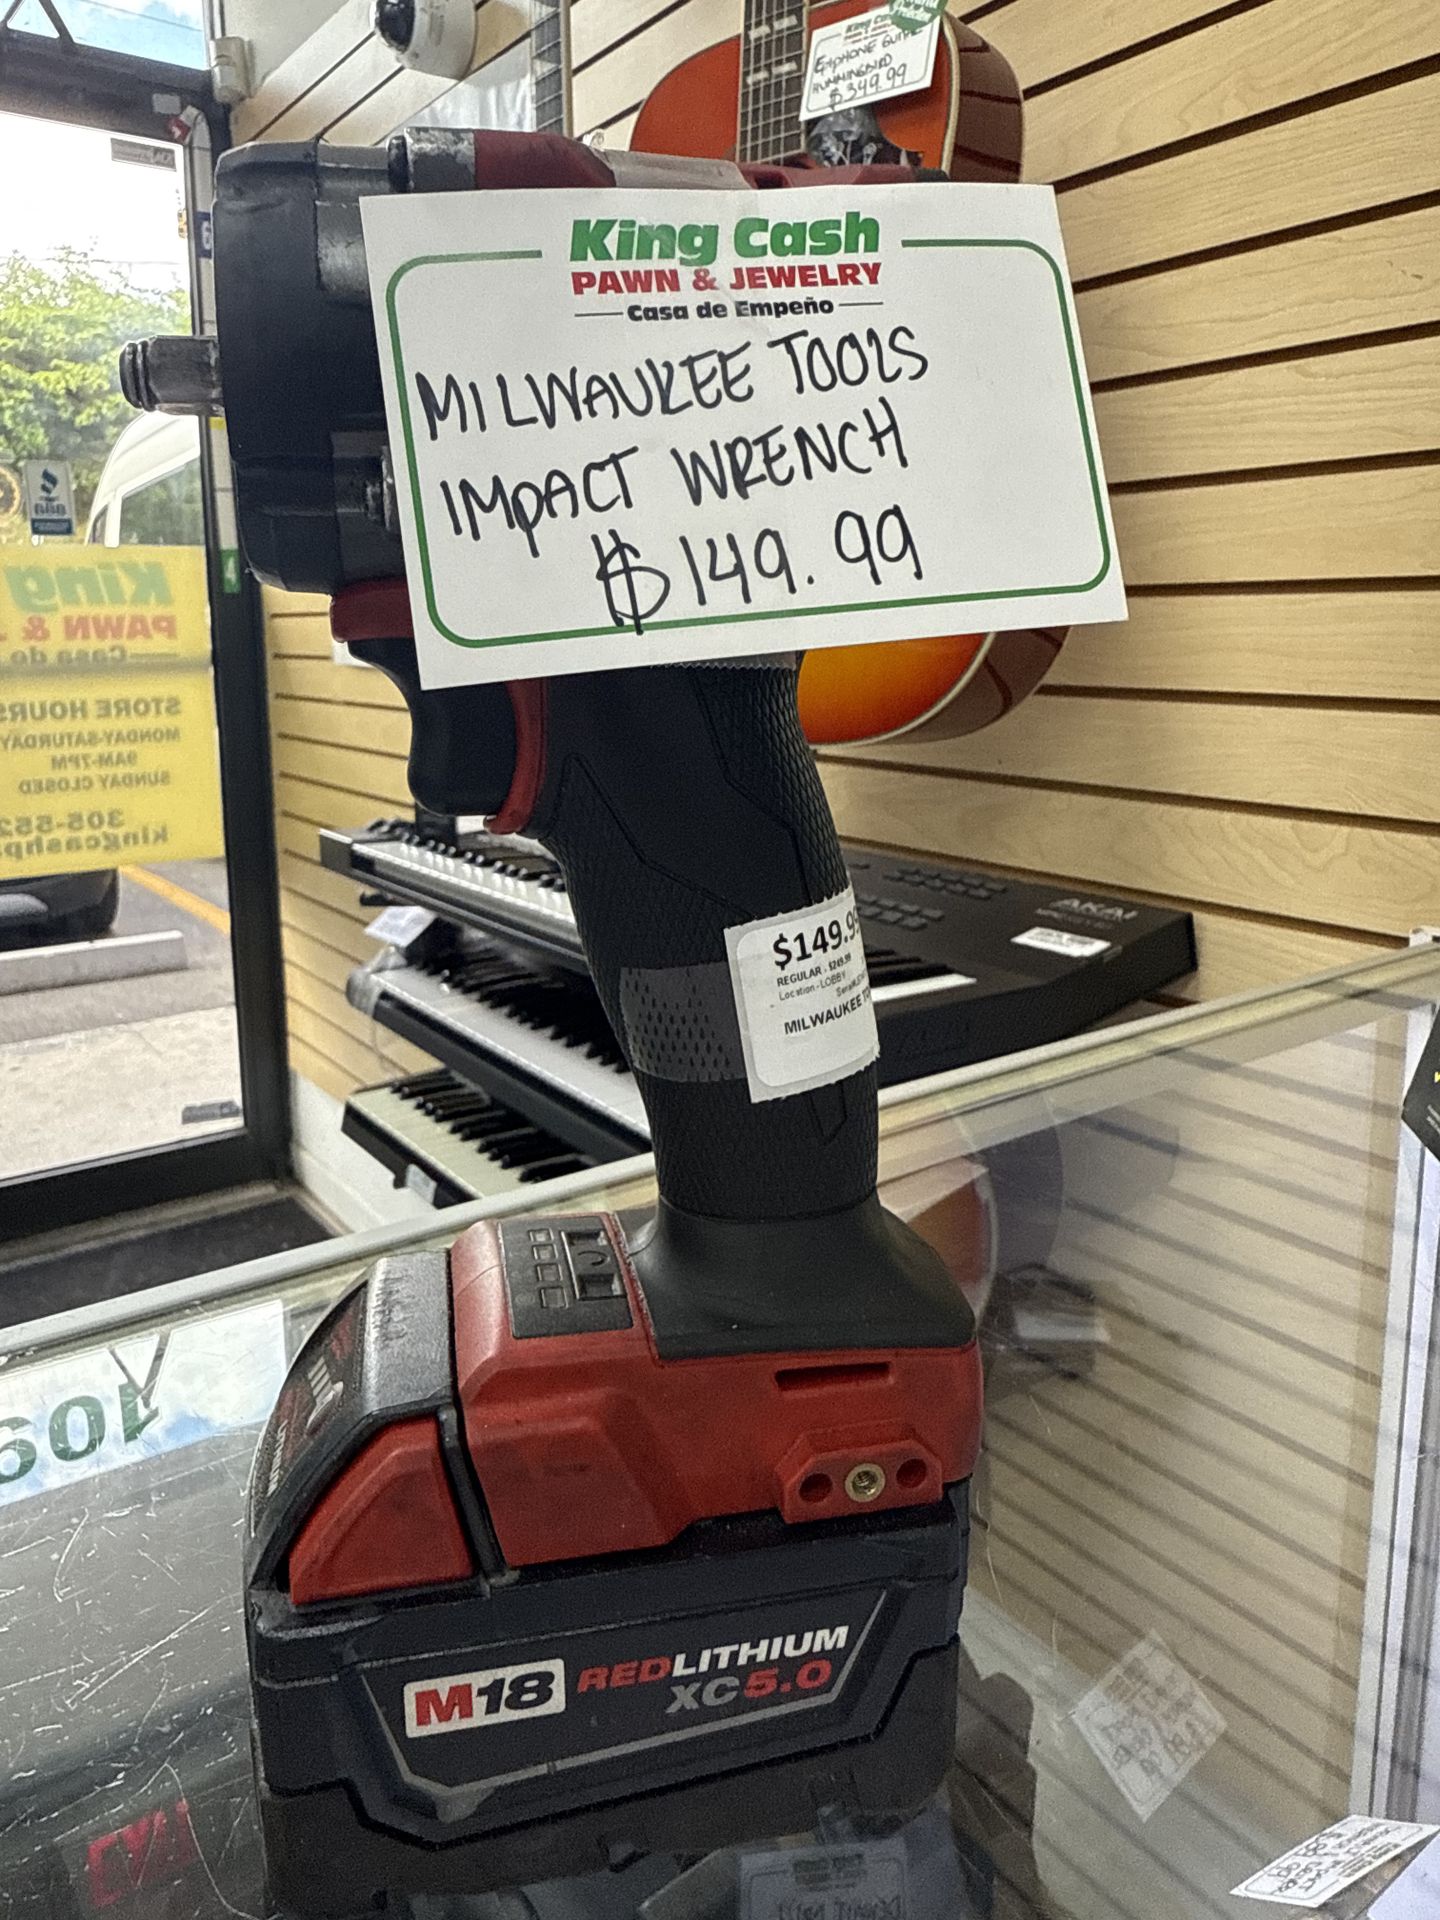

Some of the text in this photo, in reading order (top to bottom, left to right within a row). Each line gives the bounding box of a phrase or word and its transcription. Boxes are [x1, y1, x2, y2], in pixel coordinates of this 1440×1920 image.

[570, 212, 880, 267] King Cash
[571, 263, 882, 295] PAWN & JEWELRY
[627, 297, 835, 323] Casa de Empeño
[415, 326, 929, 440] MILWAUKEE TOOLS
[671, 397, 909, 506] WRENCH
[777, 966, 822, 987] REGULAR
[778, 984, 815, 1001] Location
[819, 972, 847, 990] LOBBY
[784, 995, 863, 1035] MILWAUKEE
[414, 1670, 556, 1727] M18
